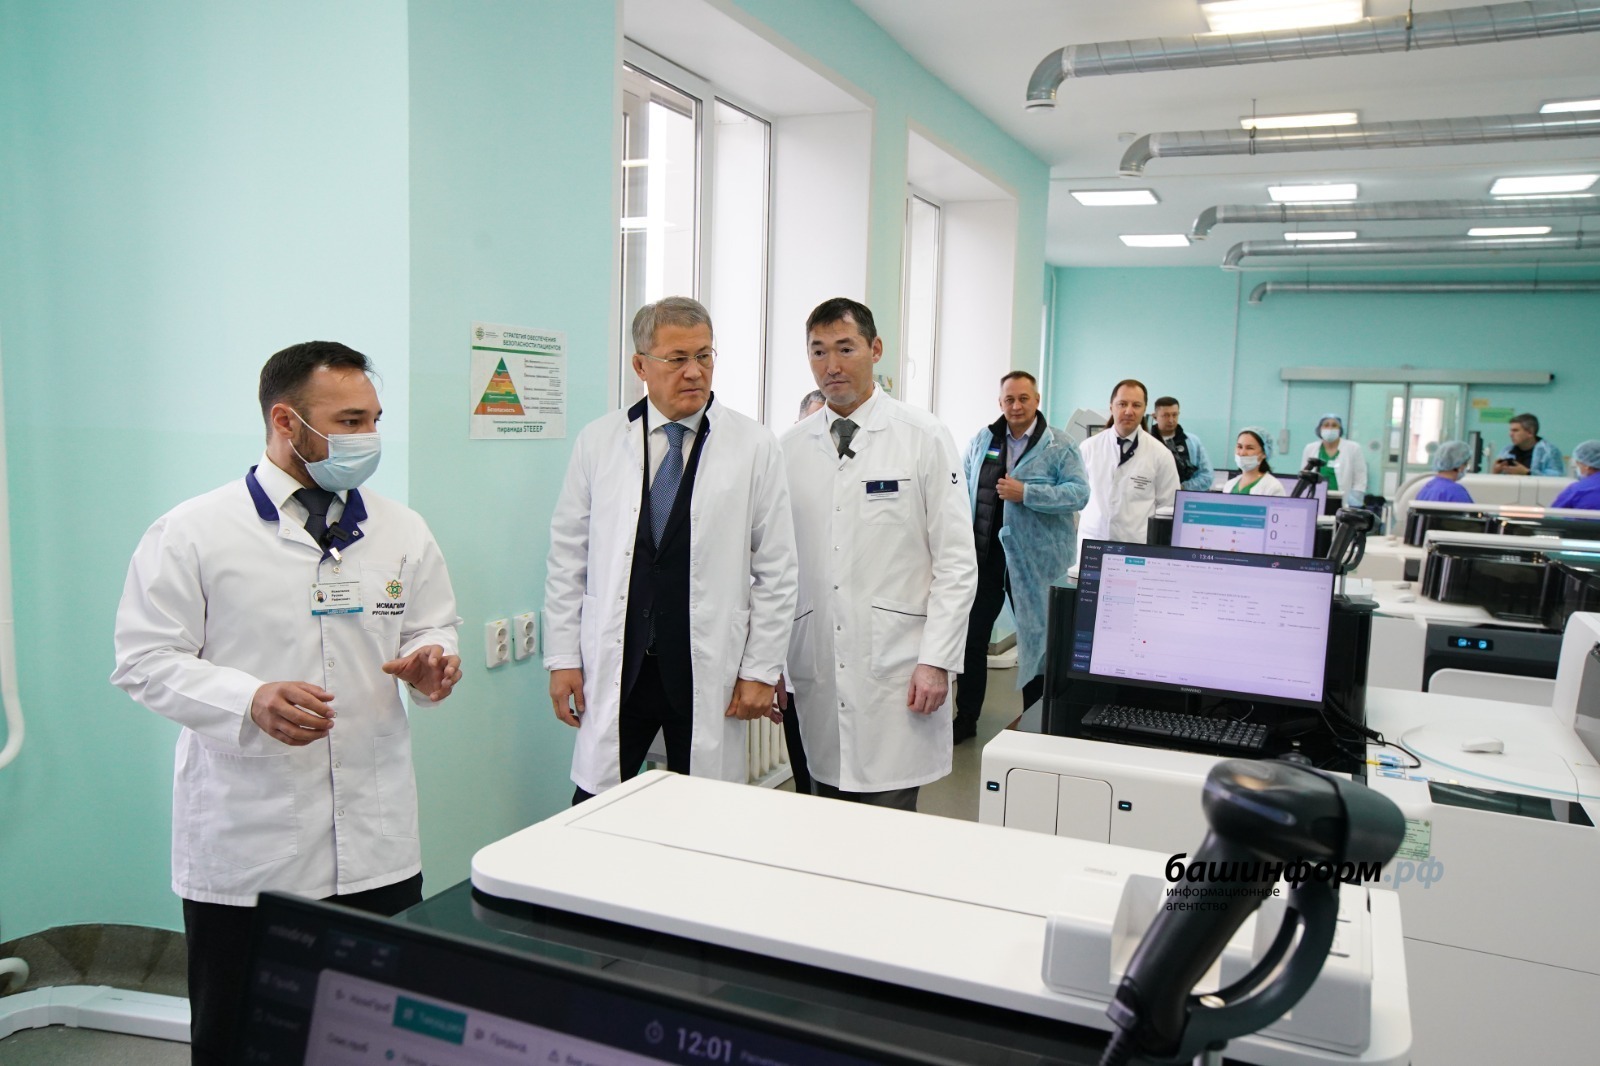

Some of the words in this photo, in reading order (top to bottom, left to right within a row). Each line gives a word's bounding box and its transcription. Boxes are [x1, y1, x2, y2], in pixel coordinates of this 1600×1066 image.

[503, 332, 527, 340] СТРАТЕГИЯ
[503, 340, 537, 348] БЕЗОПАСНОСТИ
[497, 426, 523, 434] пирамида
[1271, 513, 1279, 524] 0
[1270, 530, 1278, 540] 0
[676, 1027, 733, 1063] 12:01
